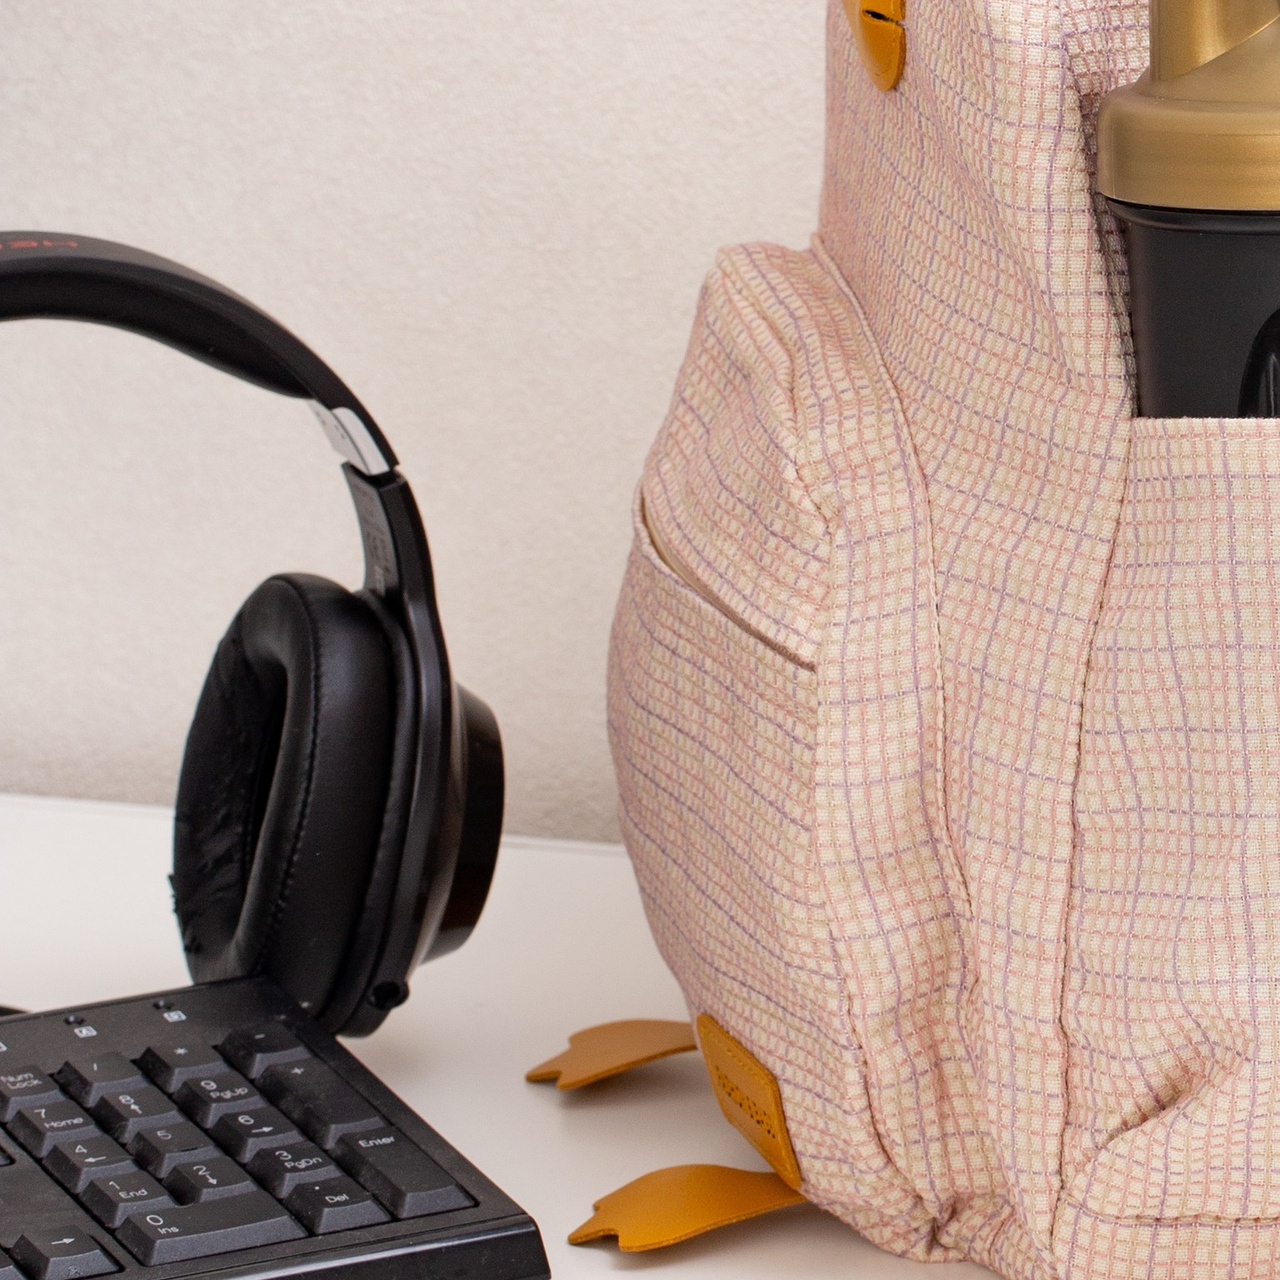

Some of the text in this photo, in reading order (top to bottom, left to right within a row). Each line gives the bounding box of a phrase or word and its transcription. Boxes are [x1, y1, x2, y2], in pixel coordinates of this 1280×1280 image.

[200, 1080, 217, 1090] 9
[210, 1087, 248, 1099] PgUp
[119, 1094, 135, 1105] 8
[34, 1108, 46, 1119] 7
[44, 1118, 83, 1128] Home
[238, 1114, 255, 1125] 6
[156, 1130, 172, 1140] 5
[358, 1136, 395, 1148] Enter
[75, 1144, 88, 1154] 4
[275, 1150, 292, 1160] 3
[284, 1157, 323, 1169] PgDn
[193, 1165, 210, 1176] 2
[108, 1180, 121, 1190] 1
[118, 1188, 149, 1199] End
[325, 1193, 350, 1204] Del
[146, 1214, 164, 1226] 0
[157, 1226, 180, 1235] Ins
